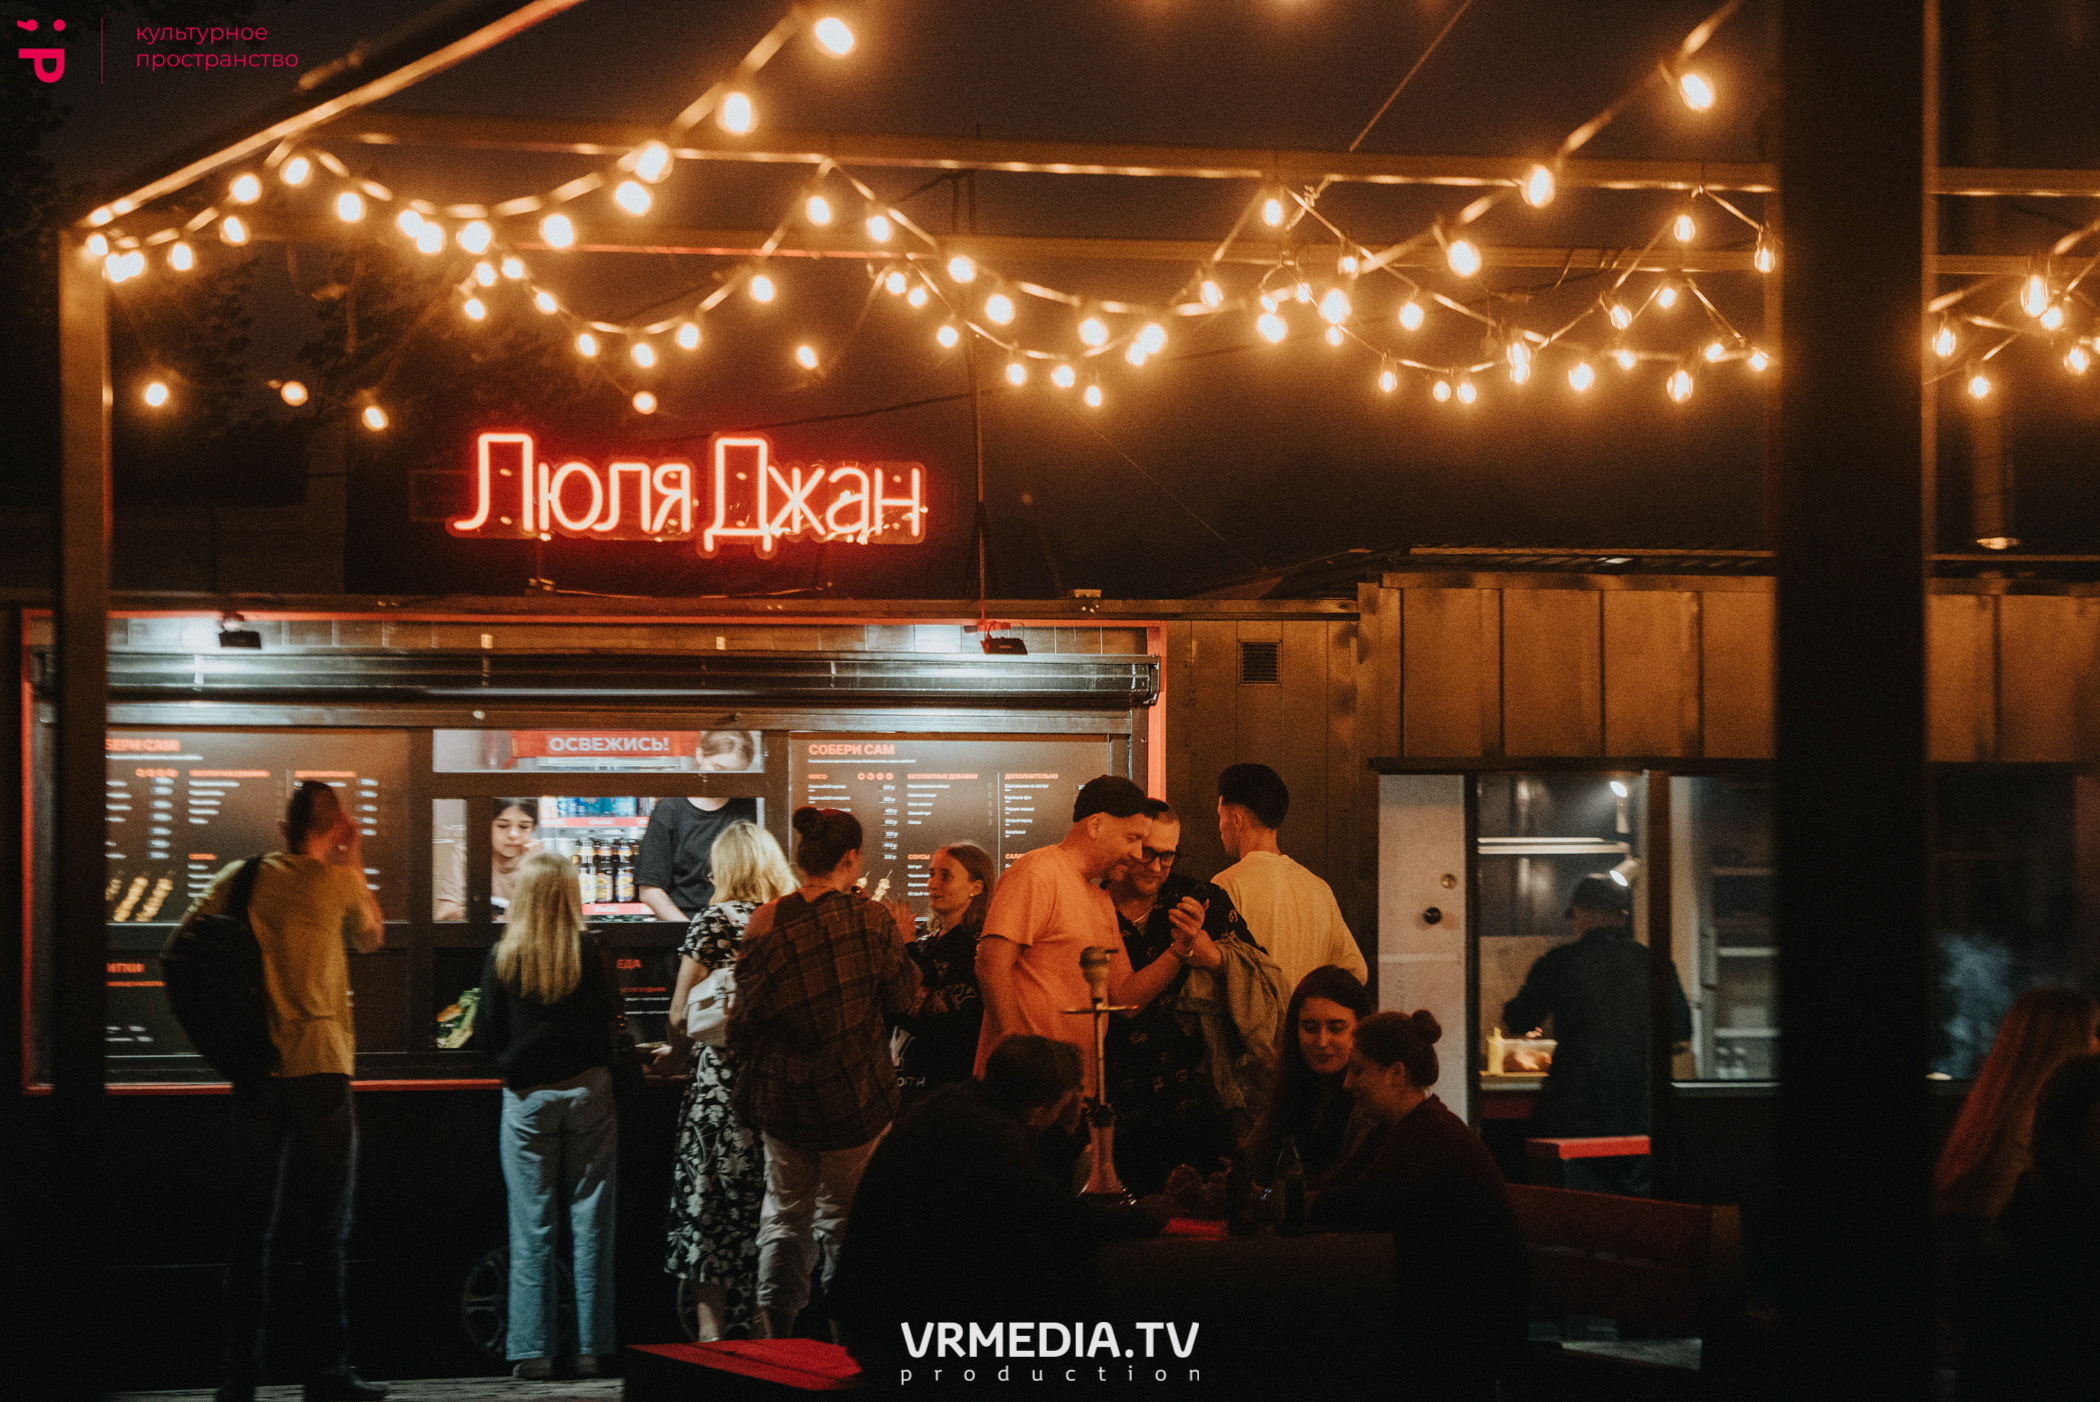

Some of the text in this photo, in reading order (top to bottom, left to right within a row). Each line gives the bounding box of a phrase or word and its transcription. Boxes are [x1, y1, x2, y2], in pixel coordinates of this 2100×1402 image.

[453, 432, 922, 553] Люля Джан
[549, 737, 670, 752] ОСВЕЖИСЬ!
[808, 743, 896, 756] СОБЕРИ САМ
[1004, 773, 1059, 781] ДОПОЛНИТЕЛЬНО
[907, 853, 931, 861] СОУСЫ
